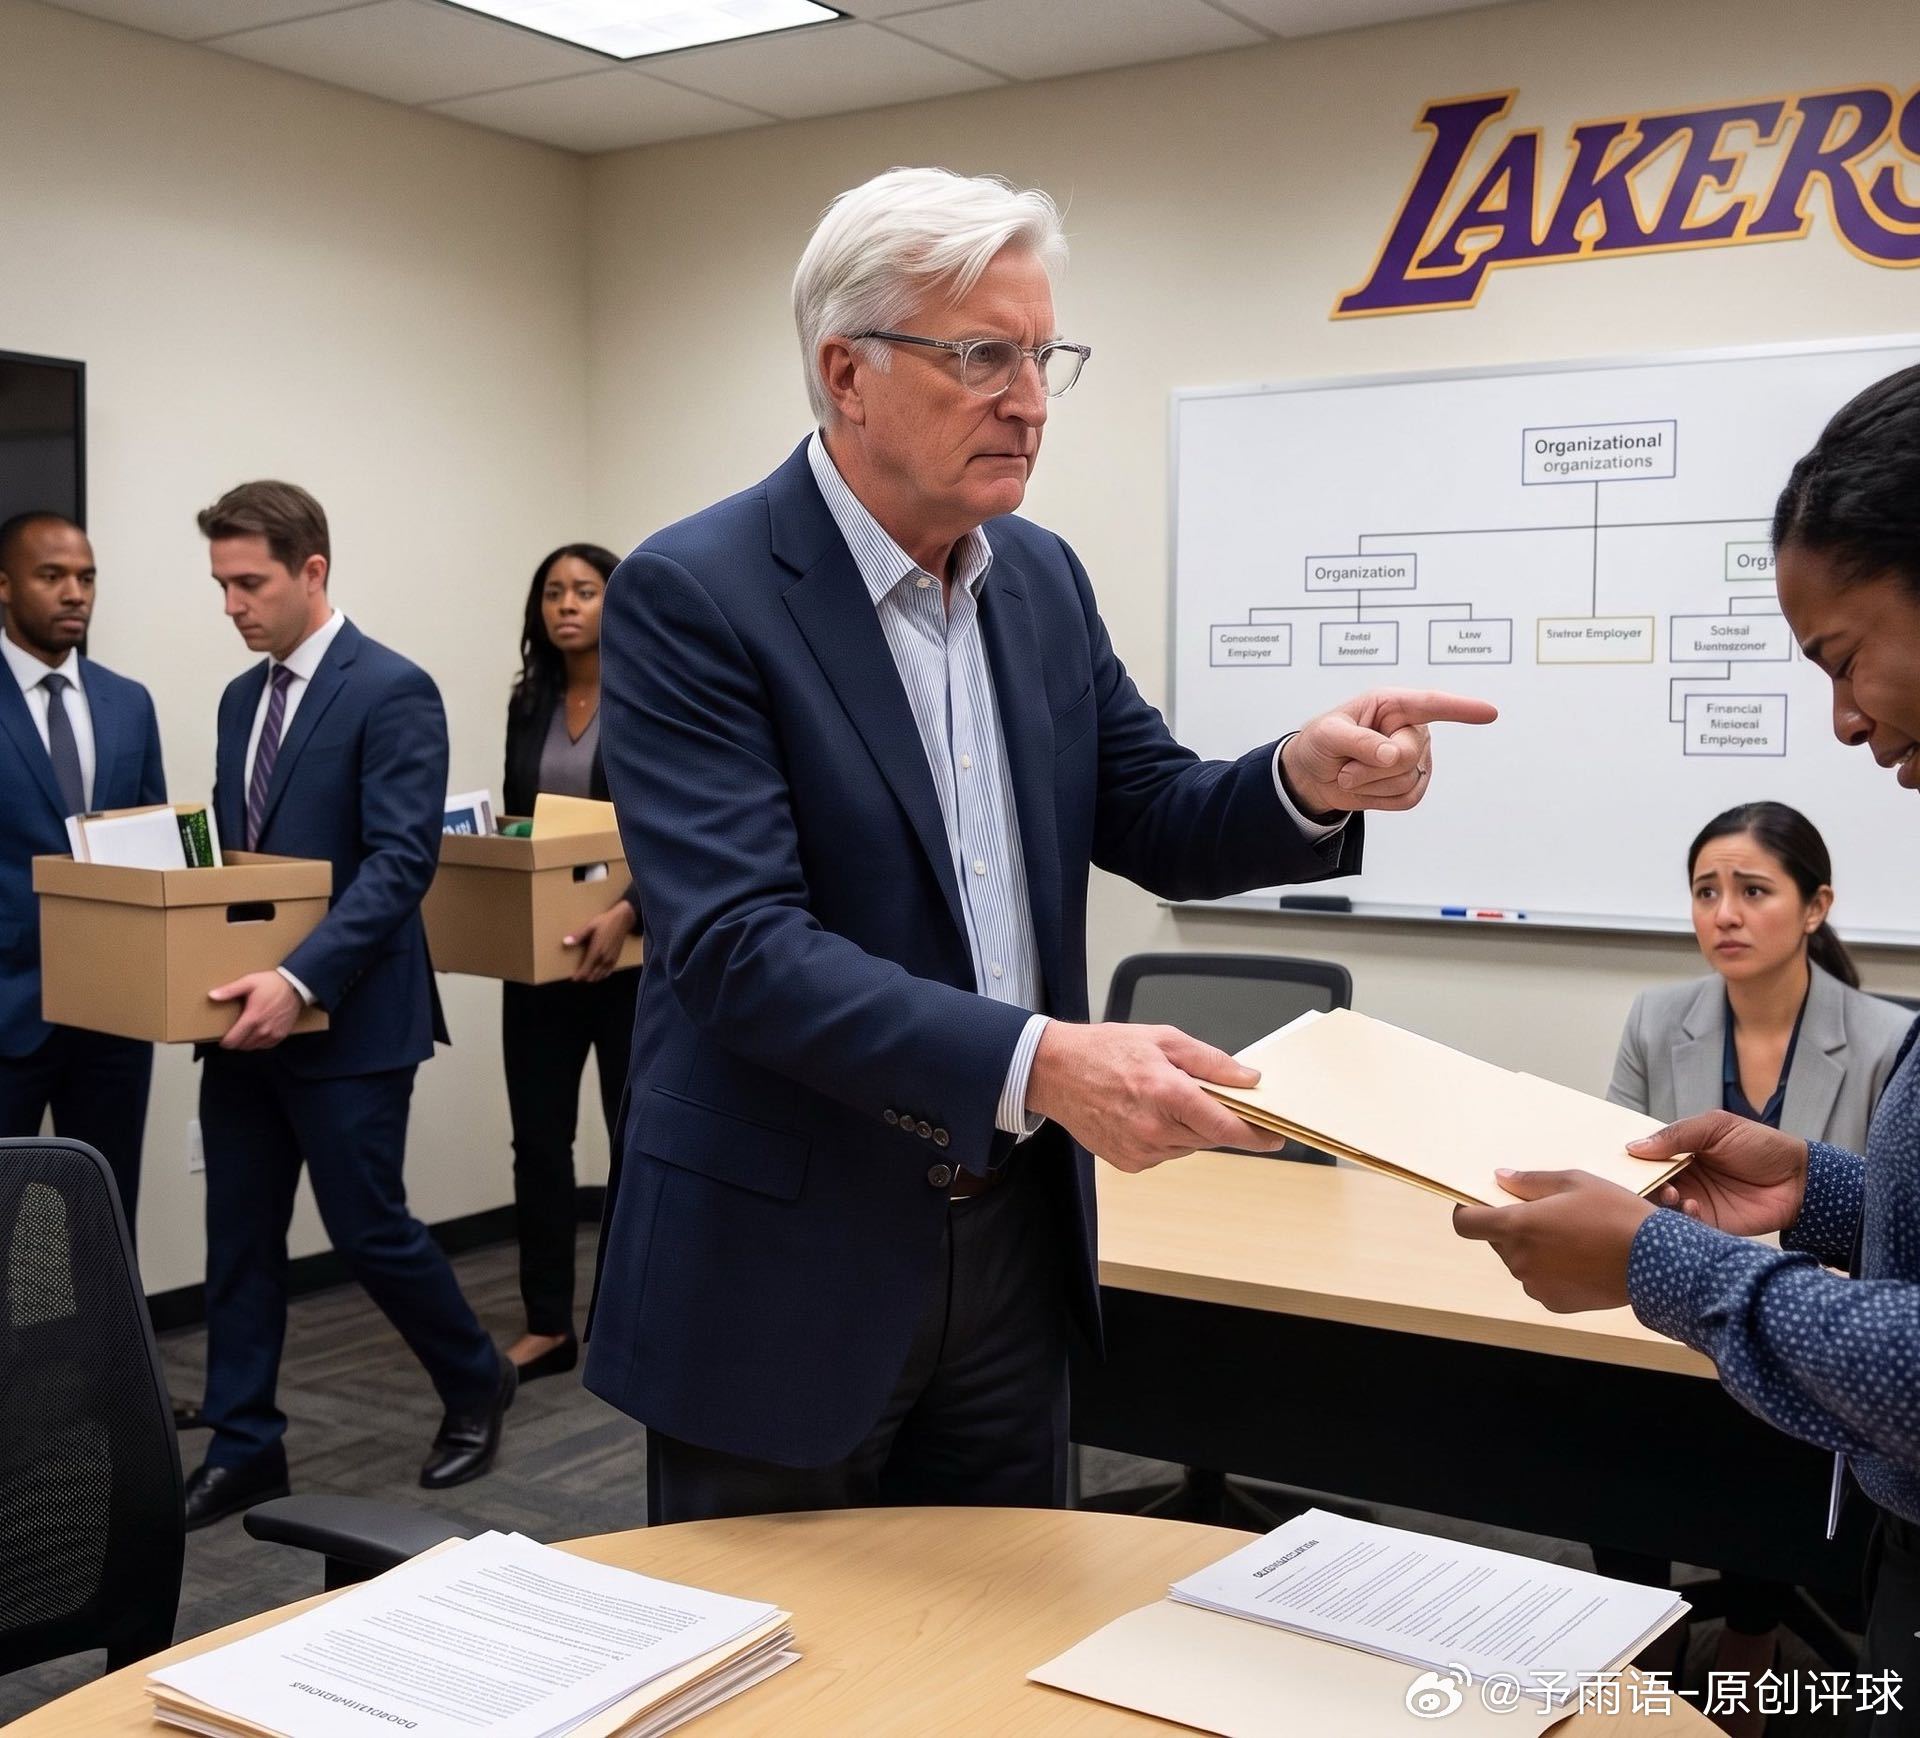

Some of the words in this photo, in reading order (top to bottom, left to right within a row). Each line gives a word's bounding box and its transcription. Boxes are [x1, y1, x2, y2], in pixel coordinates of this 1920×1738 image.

[1534, 432, 1662, 457] Organizational
[1543, 456, 1653, 475] organizations
[1314, 564, 1406, 583] Organization
[1585, 627, 1643, 641] Employer
[1706, 702, 1763, 715] Financial
[1699, 733, 1769, 748] Employees
